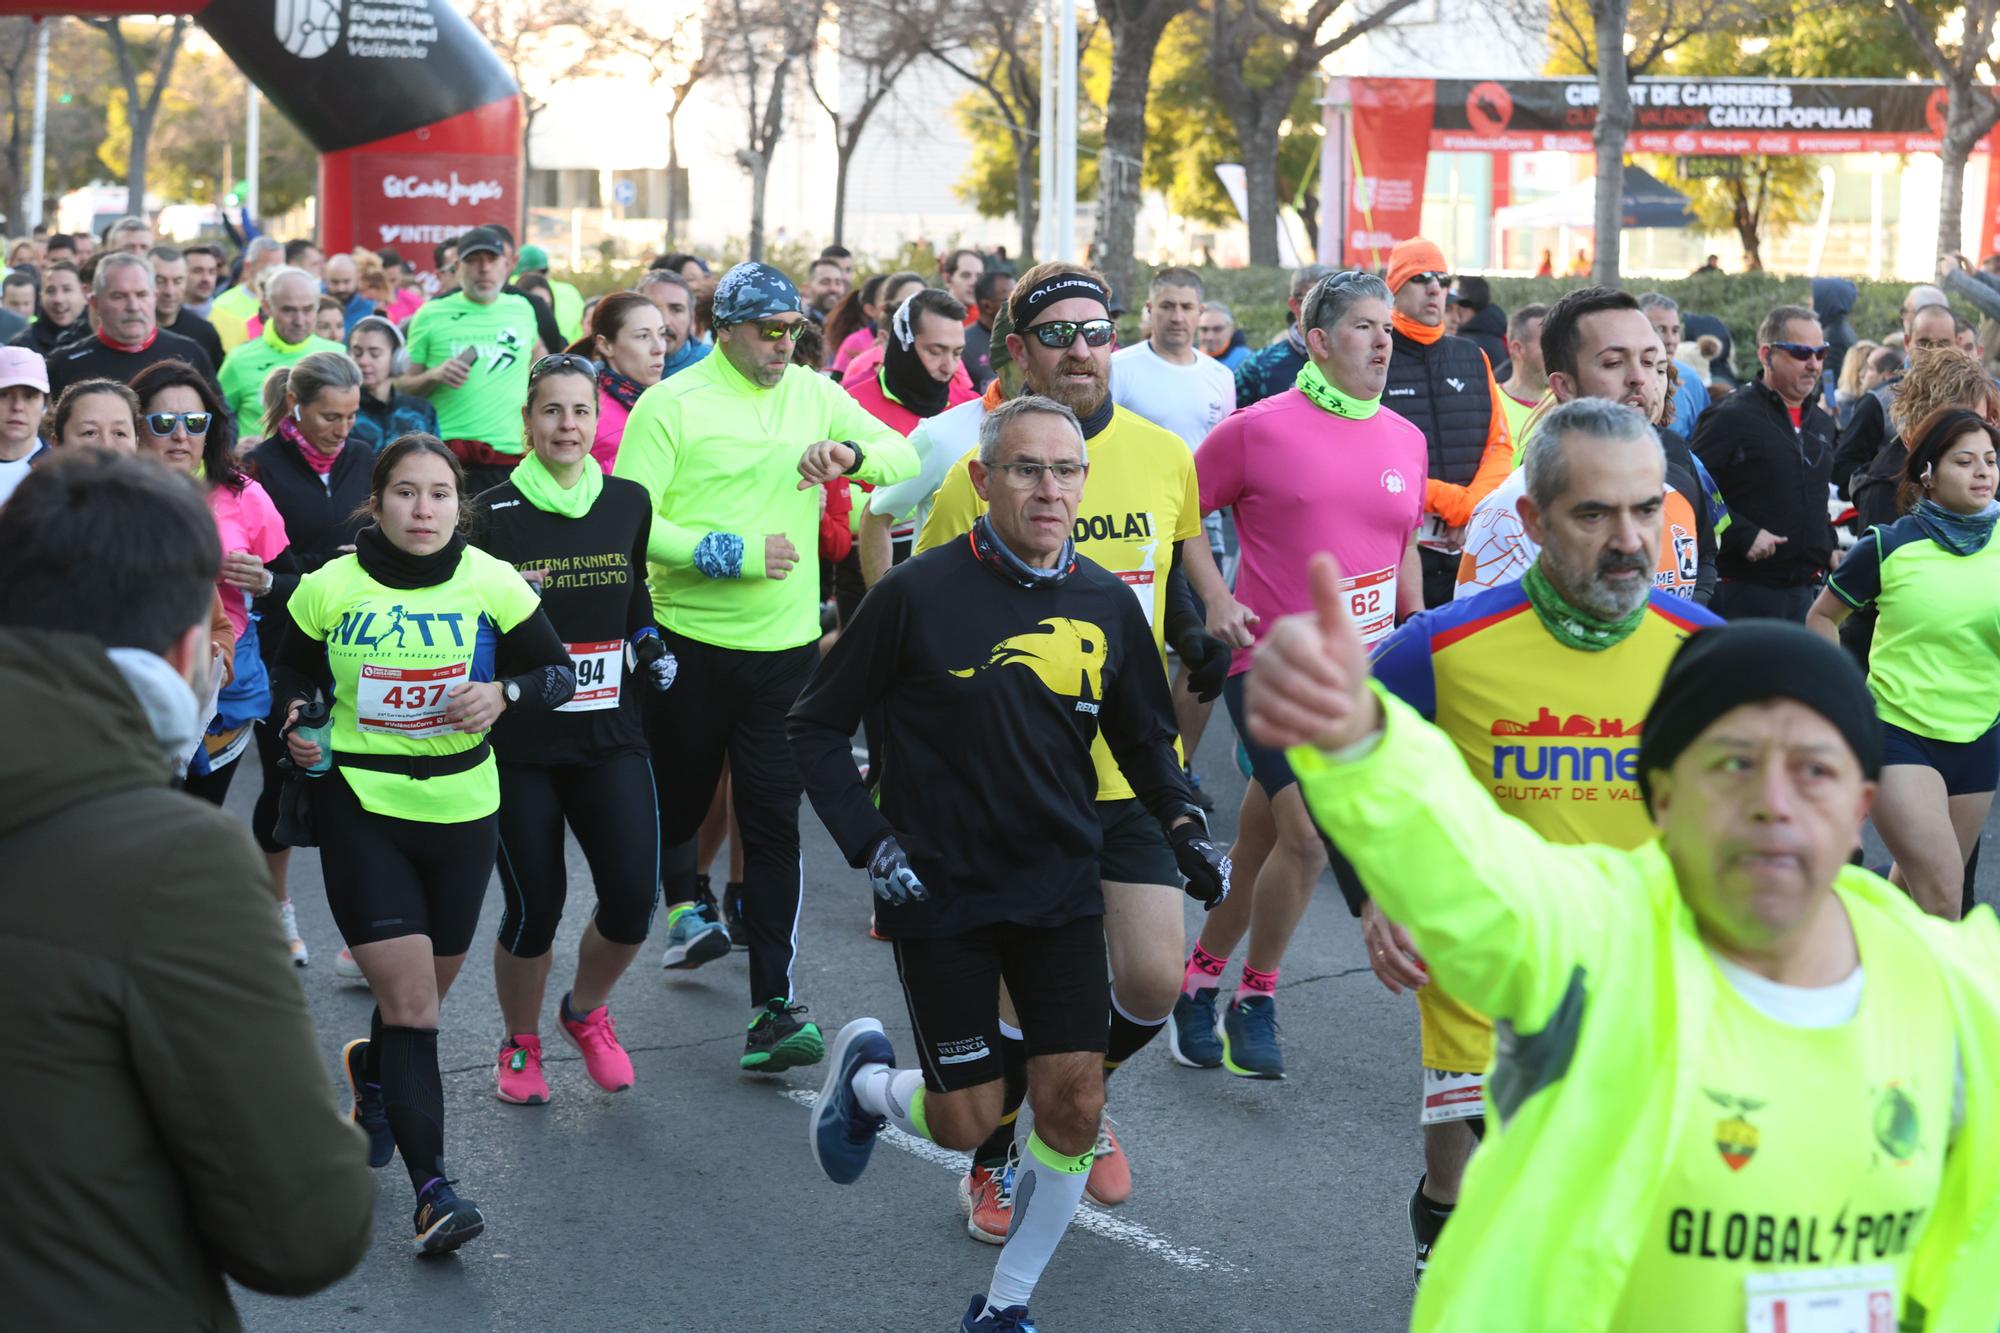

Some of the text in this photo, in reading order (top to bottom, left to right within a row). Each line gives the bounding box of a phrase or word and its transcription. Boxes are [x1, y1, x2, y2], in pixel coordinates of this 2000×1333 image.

[1650, 84, 1680, 106] DE
[1681, 84, 1792, 107] CARRERES
[1046, 280, 1104, 294] LURBEL
[573, 553, 628, 571] RUNNERS
[557, 571, 628, 589] ATLETISMO
[1351, 589, 1381, 617] 62
[573, 657, 605, 687] 94
[382, 683, 447, 710] 437
[1494, 785, 1562, 800] CIUTAT
[1572, 787, 1598, 801] DE
[1668, 1207, 1821, 1264] GLOBAL
